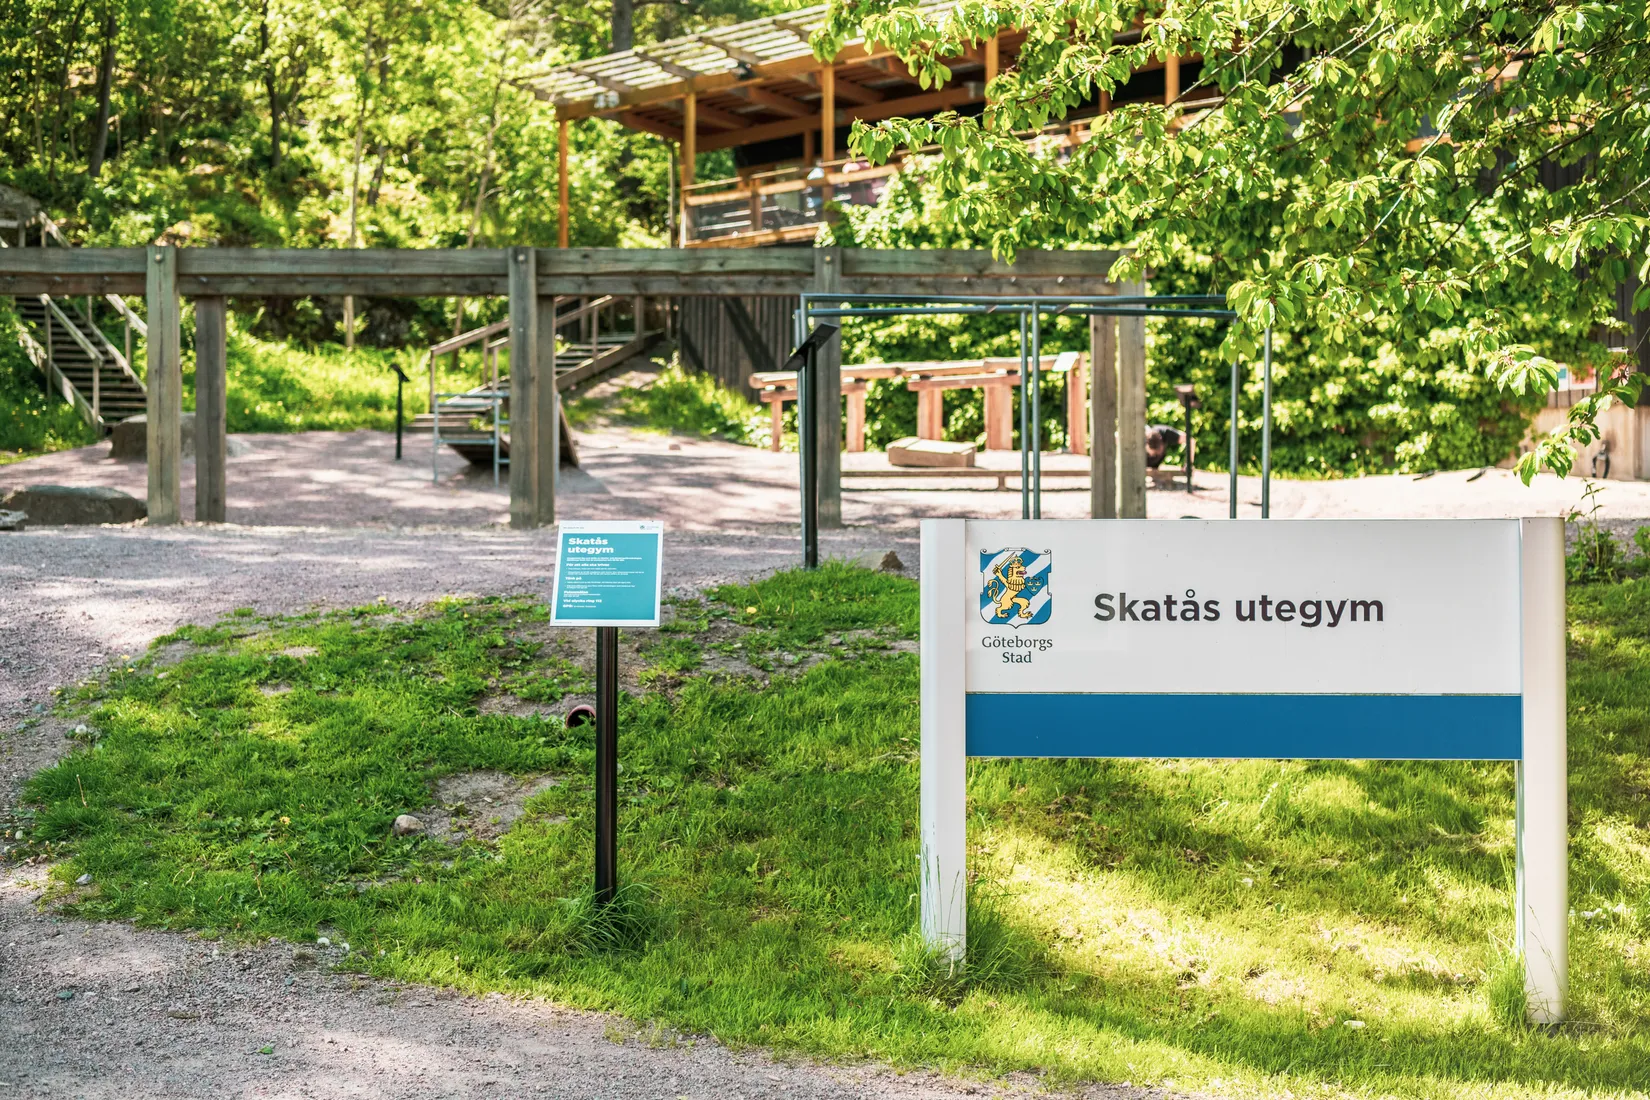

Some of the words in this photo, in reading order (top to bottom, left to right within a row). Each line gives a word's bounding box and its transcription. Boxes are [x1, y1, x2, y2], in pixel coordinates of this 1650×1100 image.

[568, 537, 609, 545] Skatås
[567, 545, 614, 554] utegym
[1093, 589, 1220, 622] Skatås
[1236, 594, 1384, 628] utegym
[981, 636, 1053, 651] Göteborgs
[1002, 651, 1032, 663] Stad
